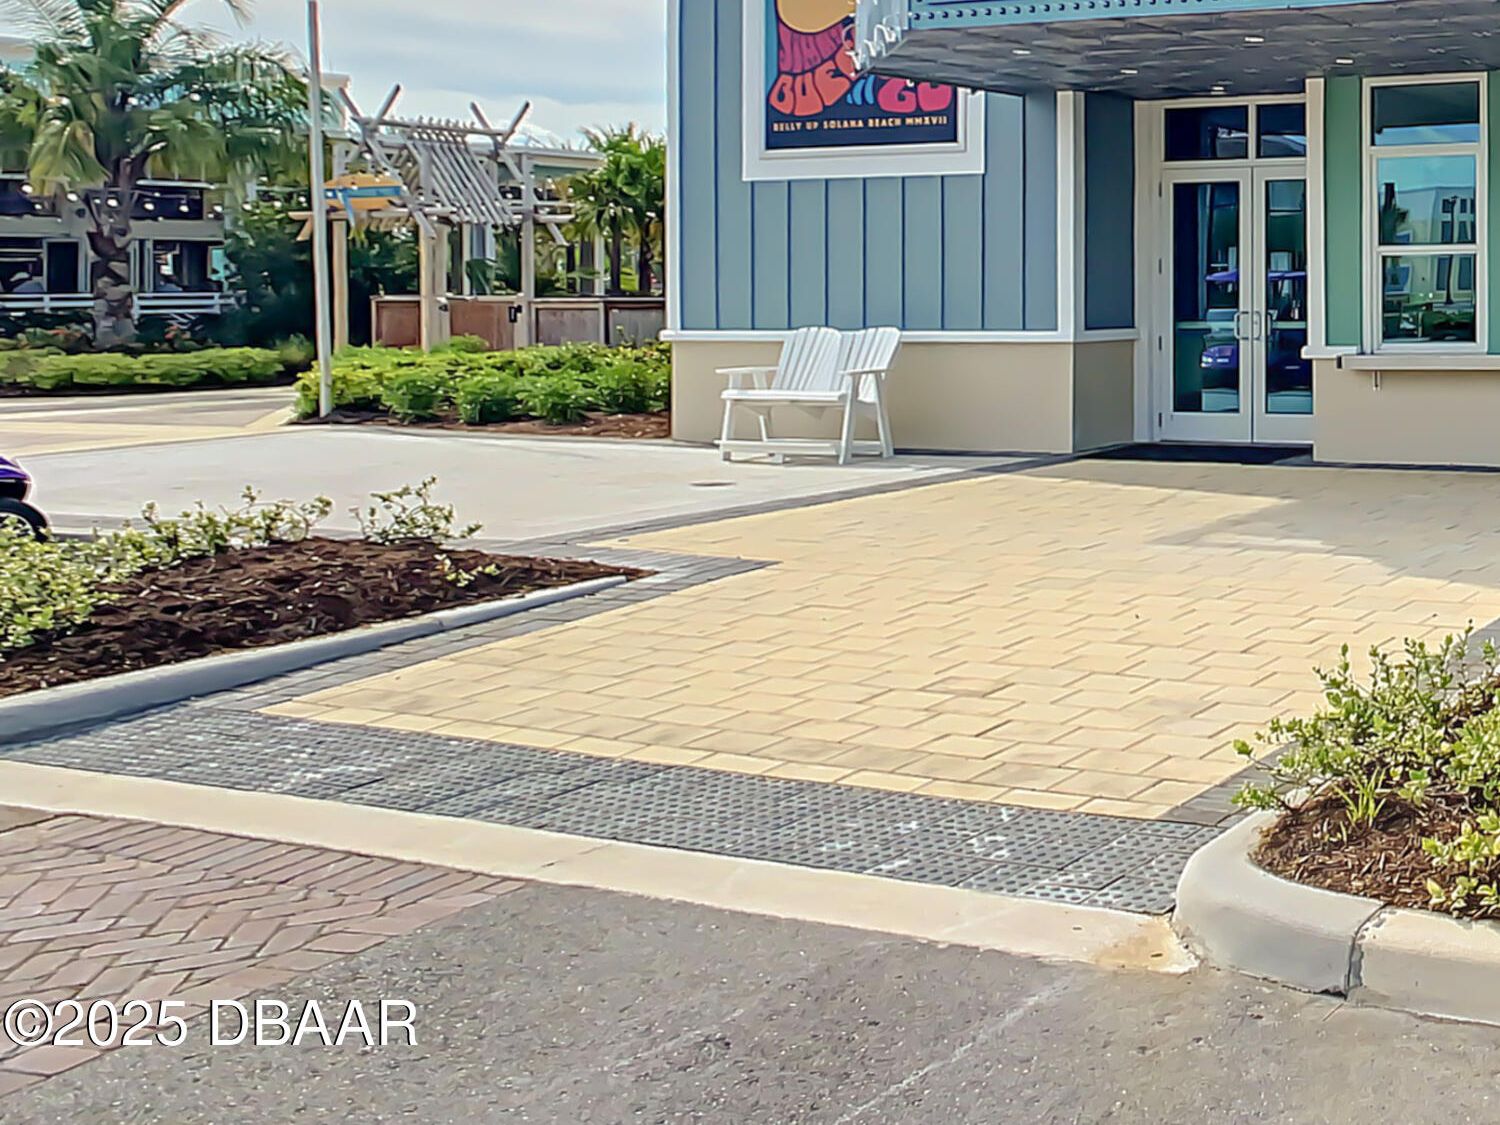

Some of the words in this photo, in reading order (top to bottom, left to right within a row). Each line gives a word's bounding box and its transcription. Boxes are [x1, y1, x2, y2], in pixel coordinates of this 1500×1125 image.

[773, 122, 802, 132] BELLY
[806, 121, 819, 130] UP
[823, 119, 863, 129] SOLANA
[868, 117, 901, 128] BEACH
[905, 115, 948, 126] MMXVII
